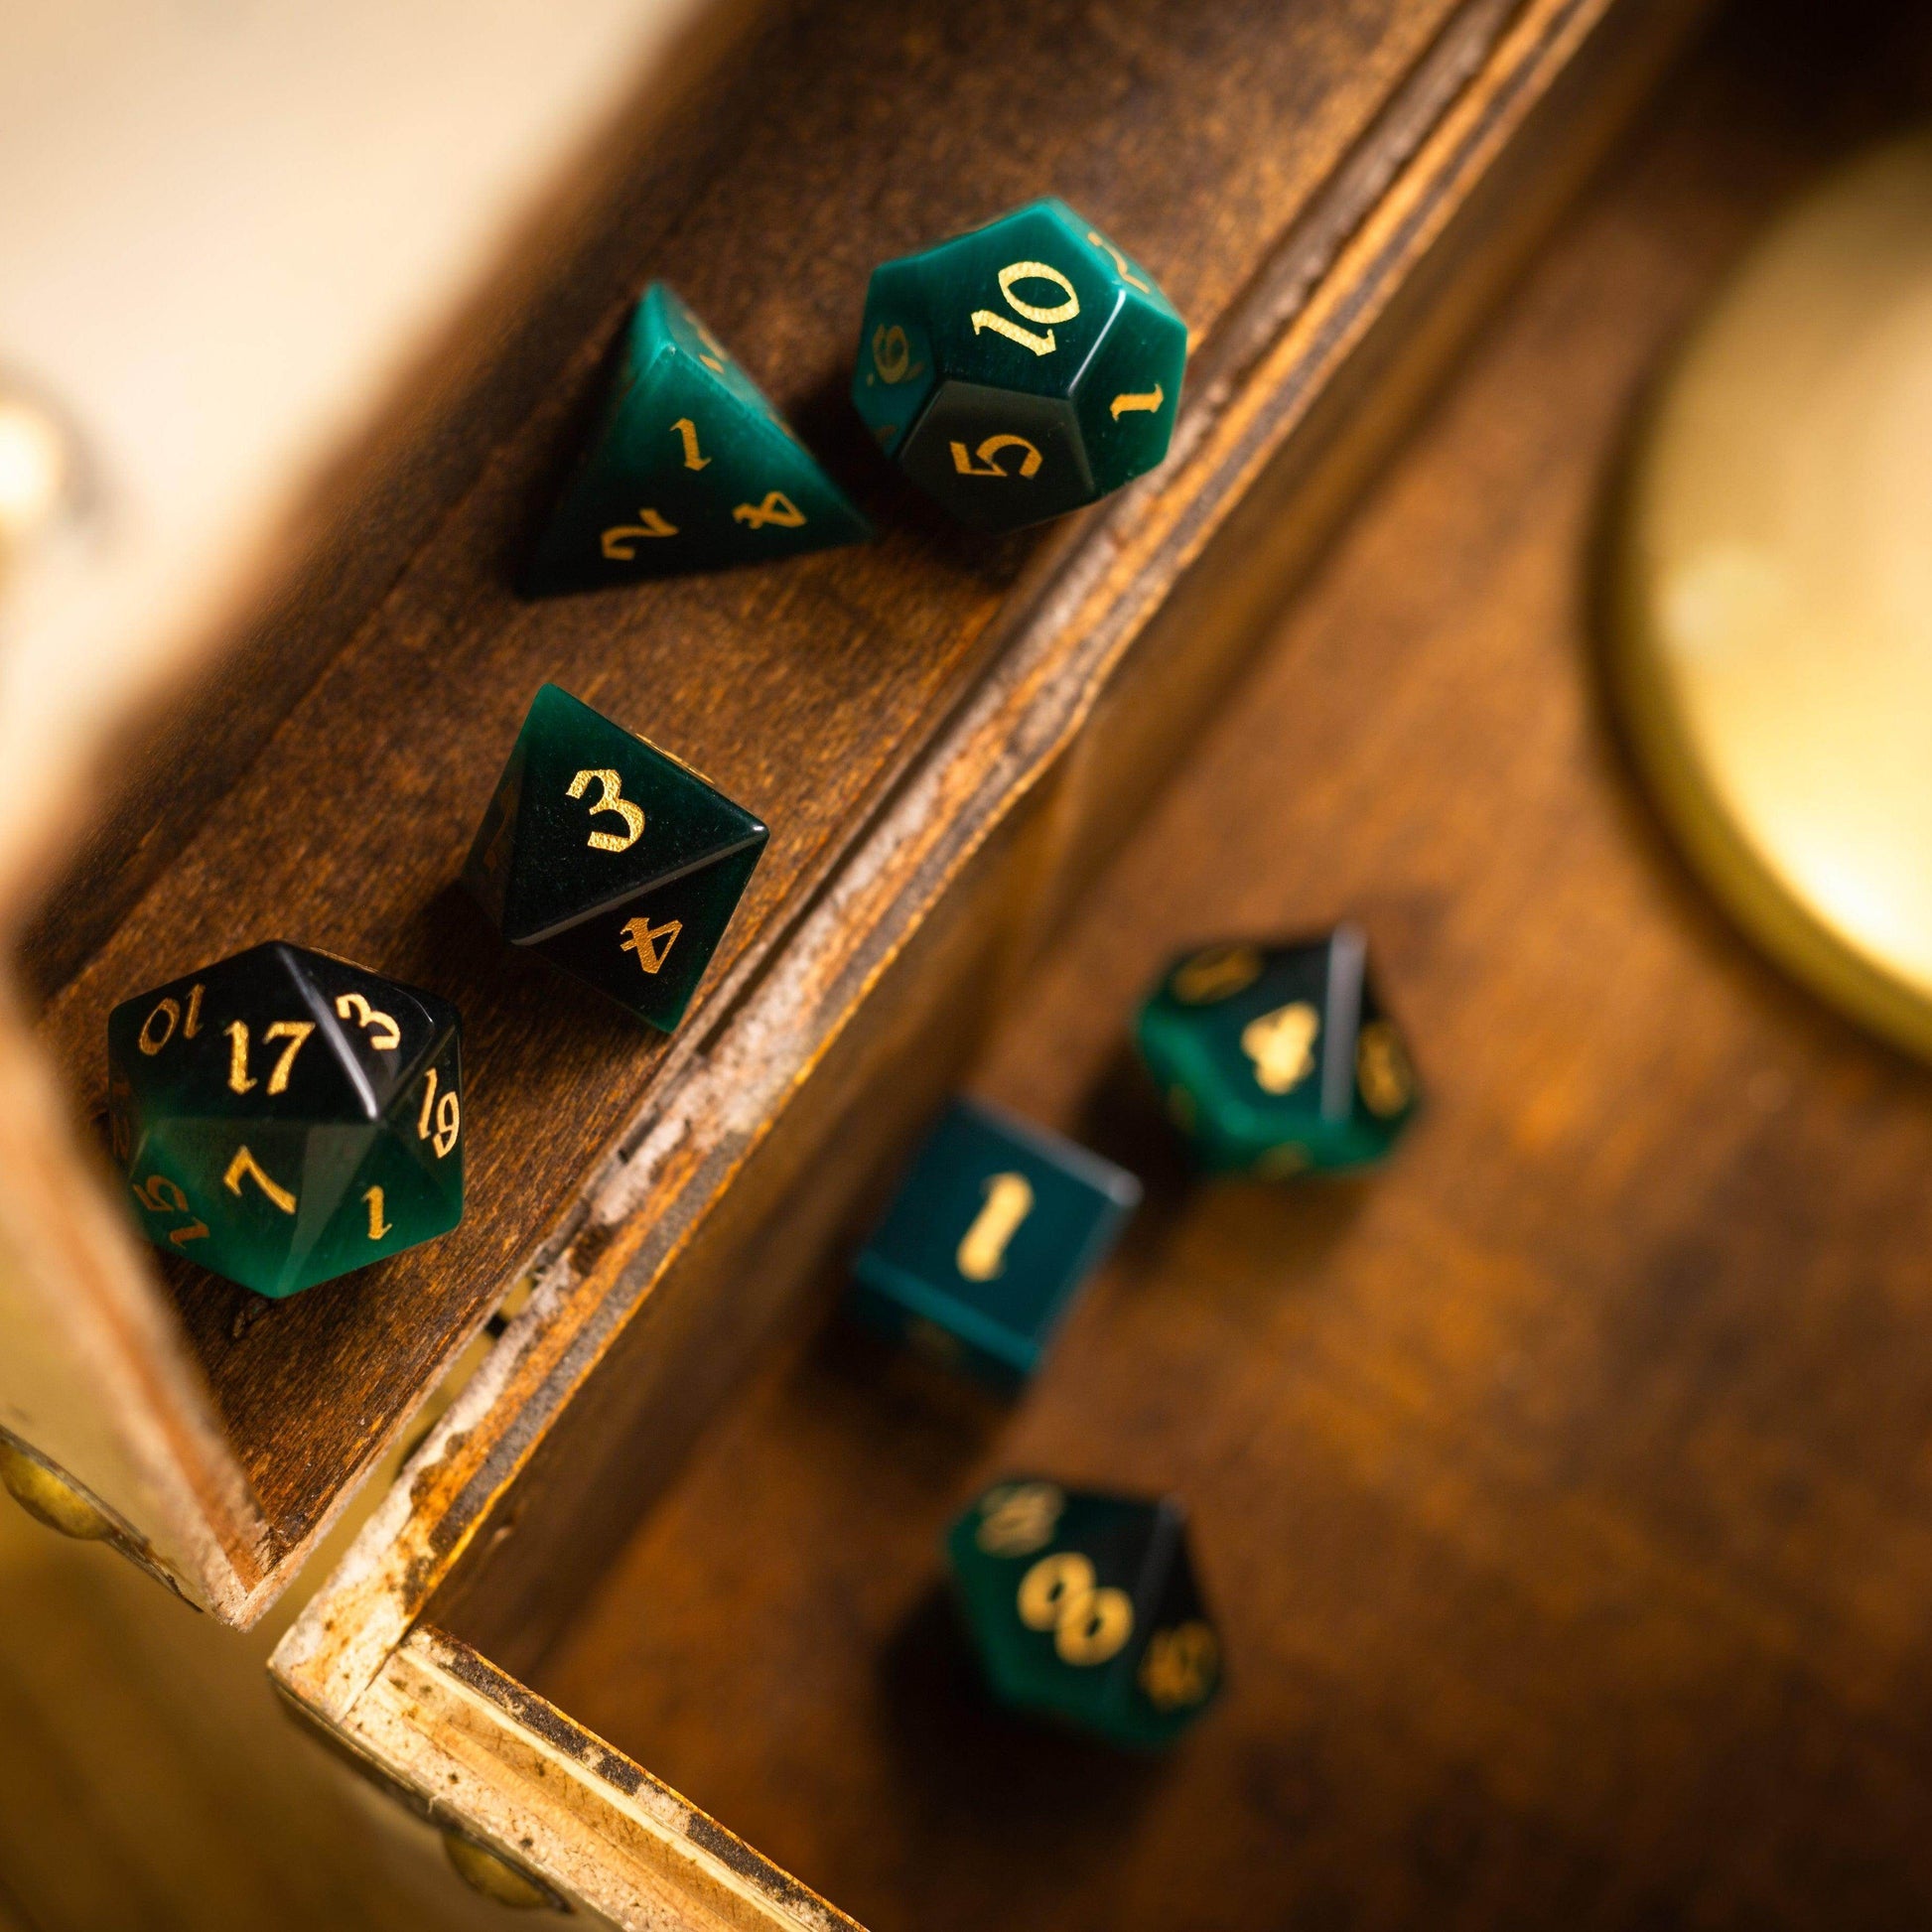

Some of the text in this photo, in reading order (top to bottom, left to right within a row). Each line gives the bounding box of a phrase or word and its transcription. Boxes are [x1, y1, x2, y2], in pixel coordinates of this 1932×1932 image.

[971, 261, 1080, 356] 10
[1110, 383, 1164, 422] 1
[670, 418, 712, 471] 1
[950, 434, 1042, 480] 5
[601, 508, 679, 560] 2
[733, 491, 807, 530] 4
[566, 769, 646, 853] 3
[620, 917, 683, 974] 4
[335, 993, 401, 1050] 3
[223, 1020, 316, 1095] 17
[418, 1067, 460, 1159] 19
[223, 1145, 296, 1214] 7
[361, 1184, 392, 1241] 1
